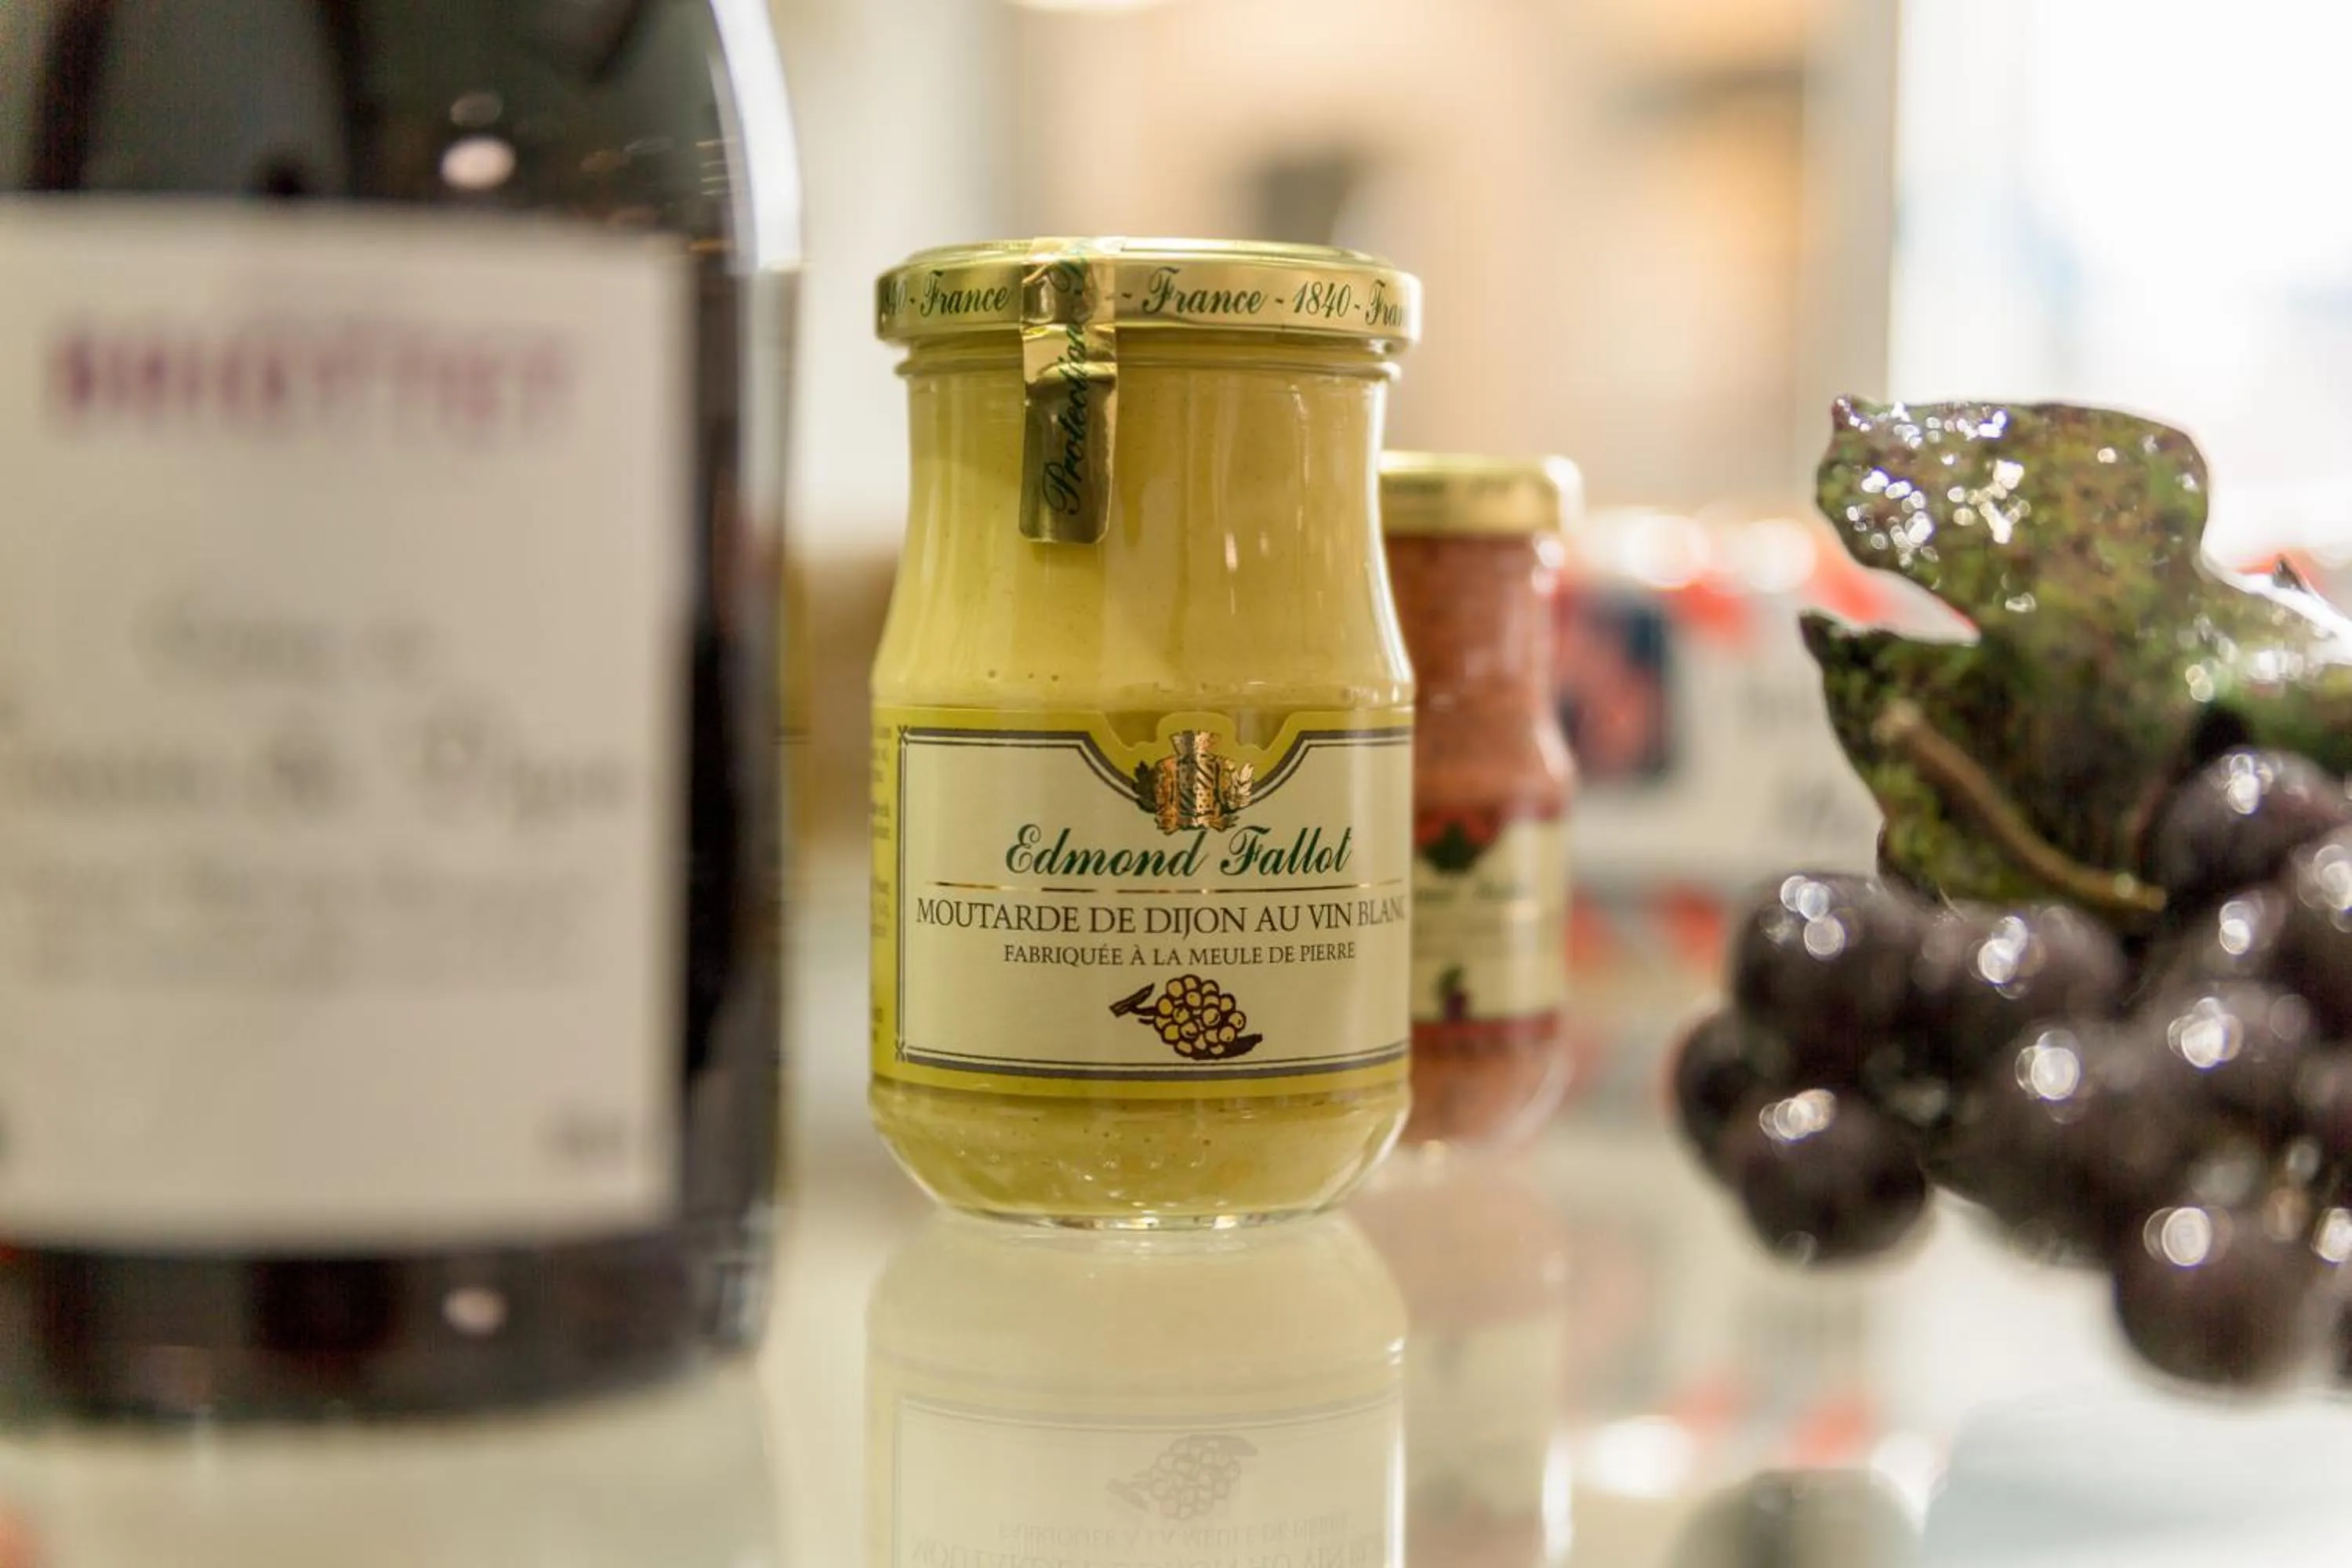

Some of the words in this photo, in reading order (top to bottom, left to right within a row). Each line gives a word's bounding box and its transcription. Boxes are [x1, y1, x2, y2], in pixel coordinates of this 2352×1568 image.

[920, 270, 1011, 318] France
[1142, 266, 1268, 314] France
[1293, 281, 1352, 319] 1840
[1006, 823, 1210, 877] Edmond
[1219, 825, 1352, 877] Fallot
[916, 897, 1081, 933] MOUTARDE
[1087, 906, 1136, 934] DE
[1143, 906, 1248, 941] DIJON
[1254, 905, 1301, 933] AU
[1307, 902, 1353, 931] VIN
[1004, 943, 1124, 967] FABRIQUÉE
[1130, 943, 1147, 966] À
[1152, 947, 1182, 966] LA
[1189, 946, 1263, 966] MEULE
[1269, 946, 1294, 964] DE
[1299, 941, 1356, 962] PIERRE
